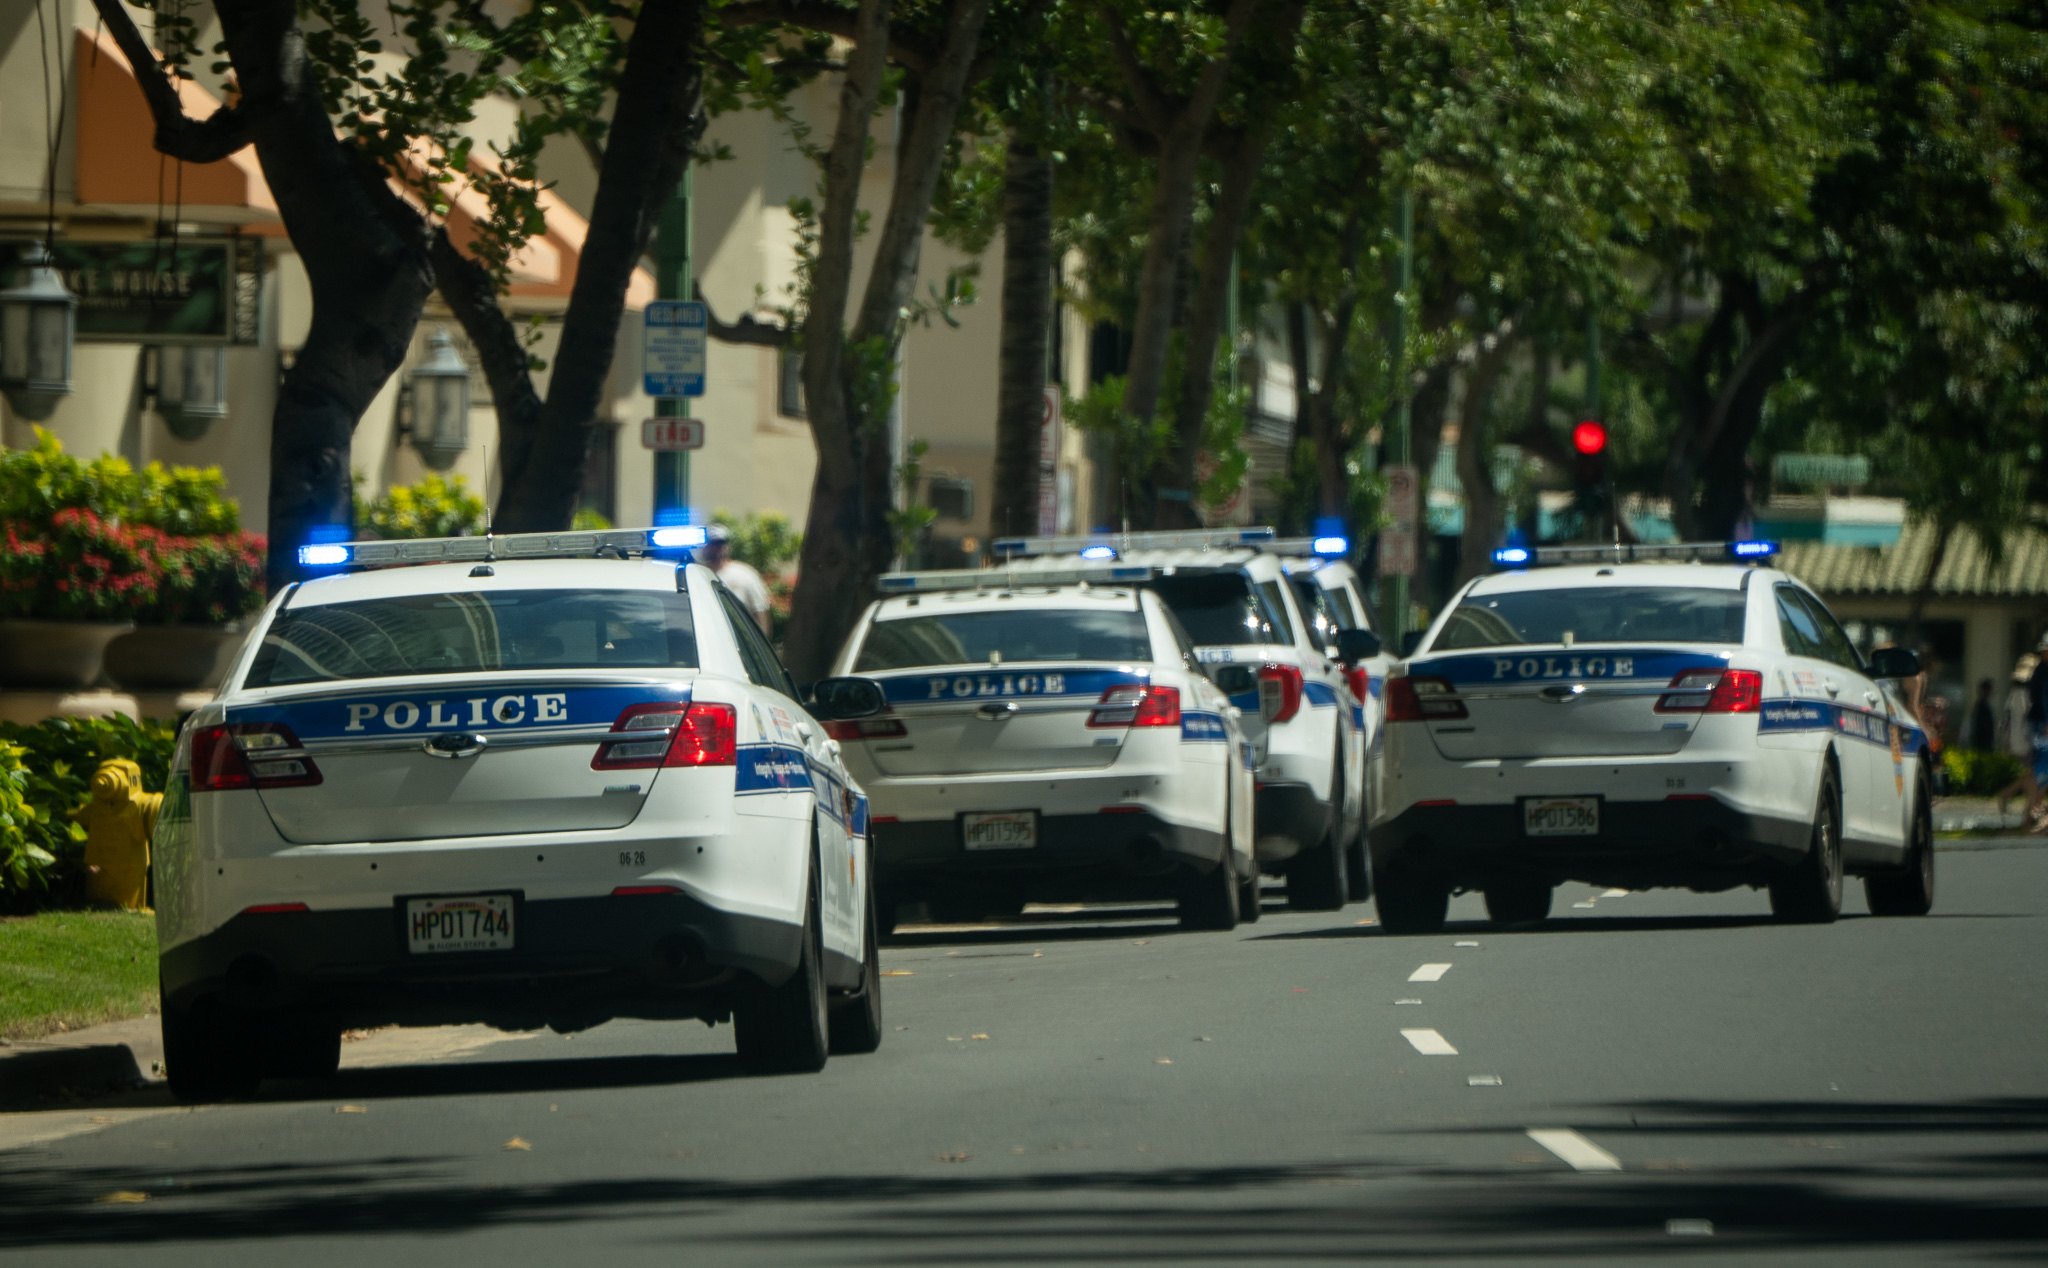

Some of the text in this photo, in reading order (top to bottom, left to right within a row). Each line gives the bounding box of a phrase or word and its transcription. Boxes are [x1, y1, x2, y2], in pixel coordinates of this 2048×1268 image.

[655, 425, 691, 442] END
[1199, 648, 1234, 663] ICE
[1493, 657, 1634, 679] POLICE
[928, 674, 1066, 698] POLICE
[345, 694, 567, 731] POLICE
[1528, 808, 1596, 829] HPD1586
[620, 851, 646, 866] 06 26
[413, 908, 510, 940] HPD1744
[437, 941, 487, 950] ALOHA STATE
